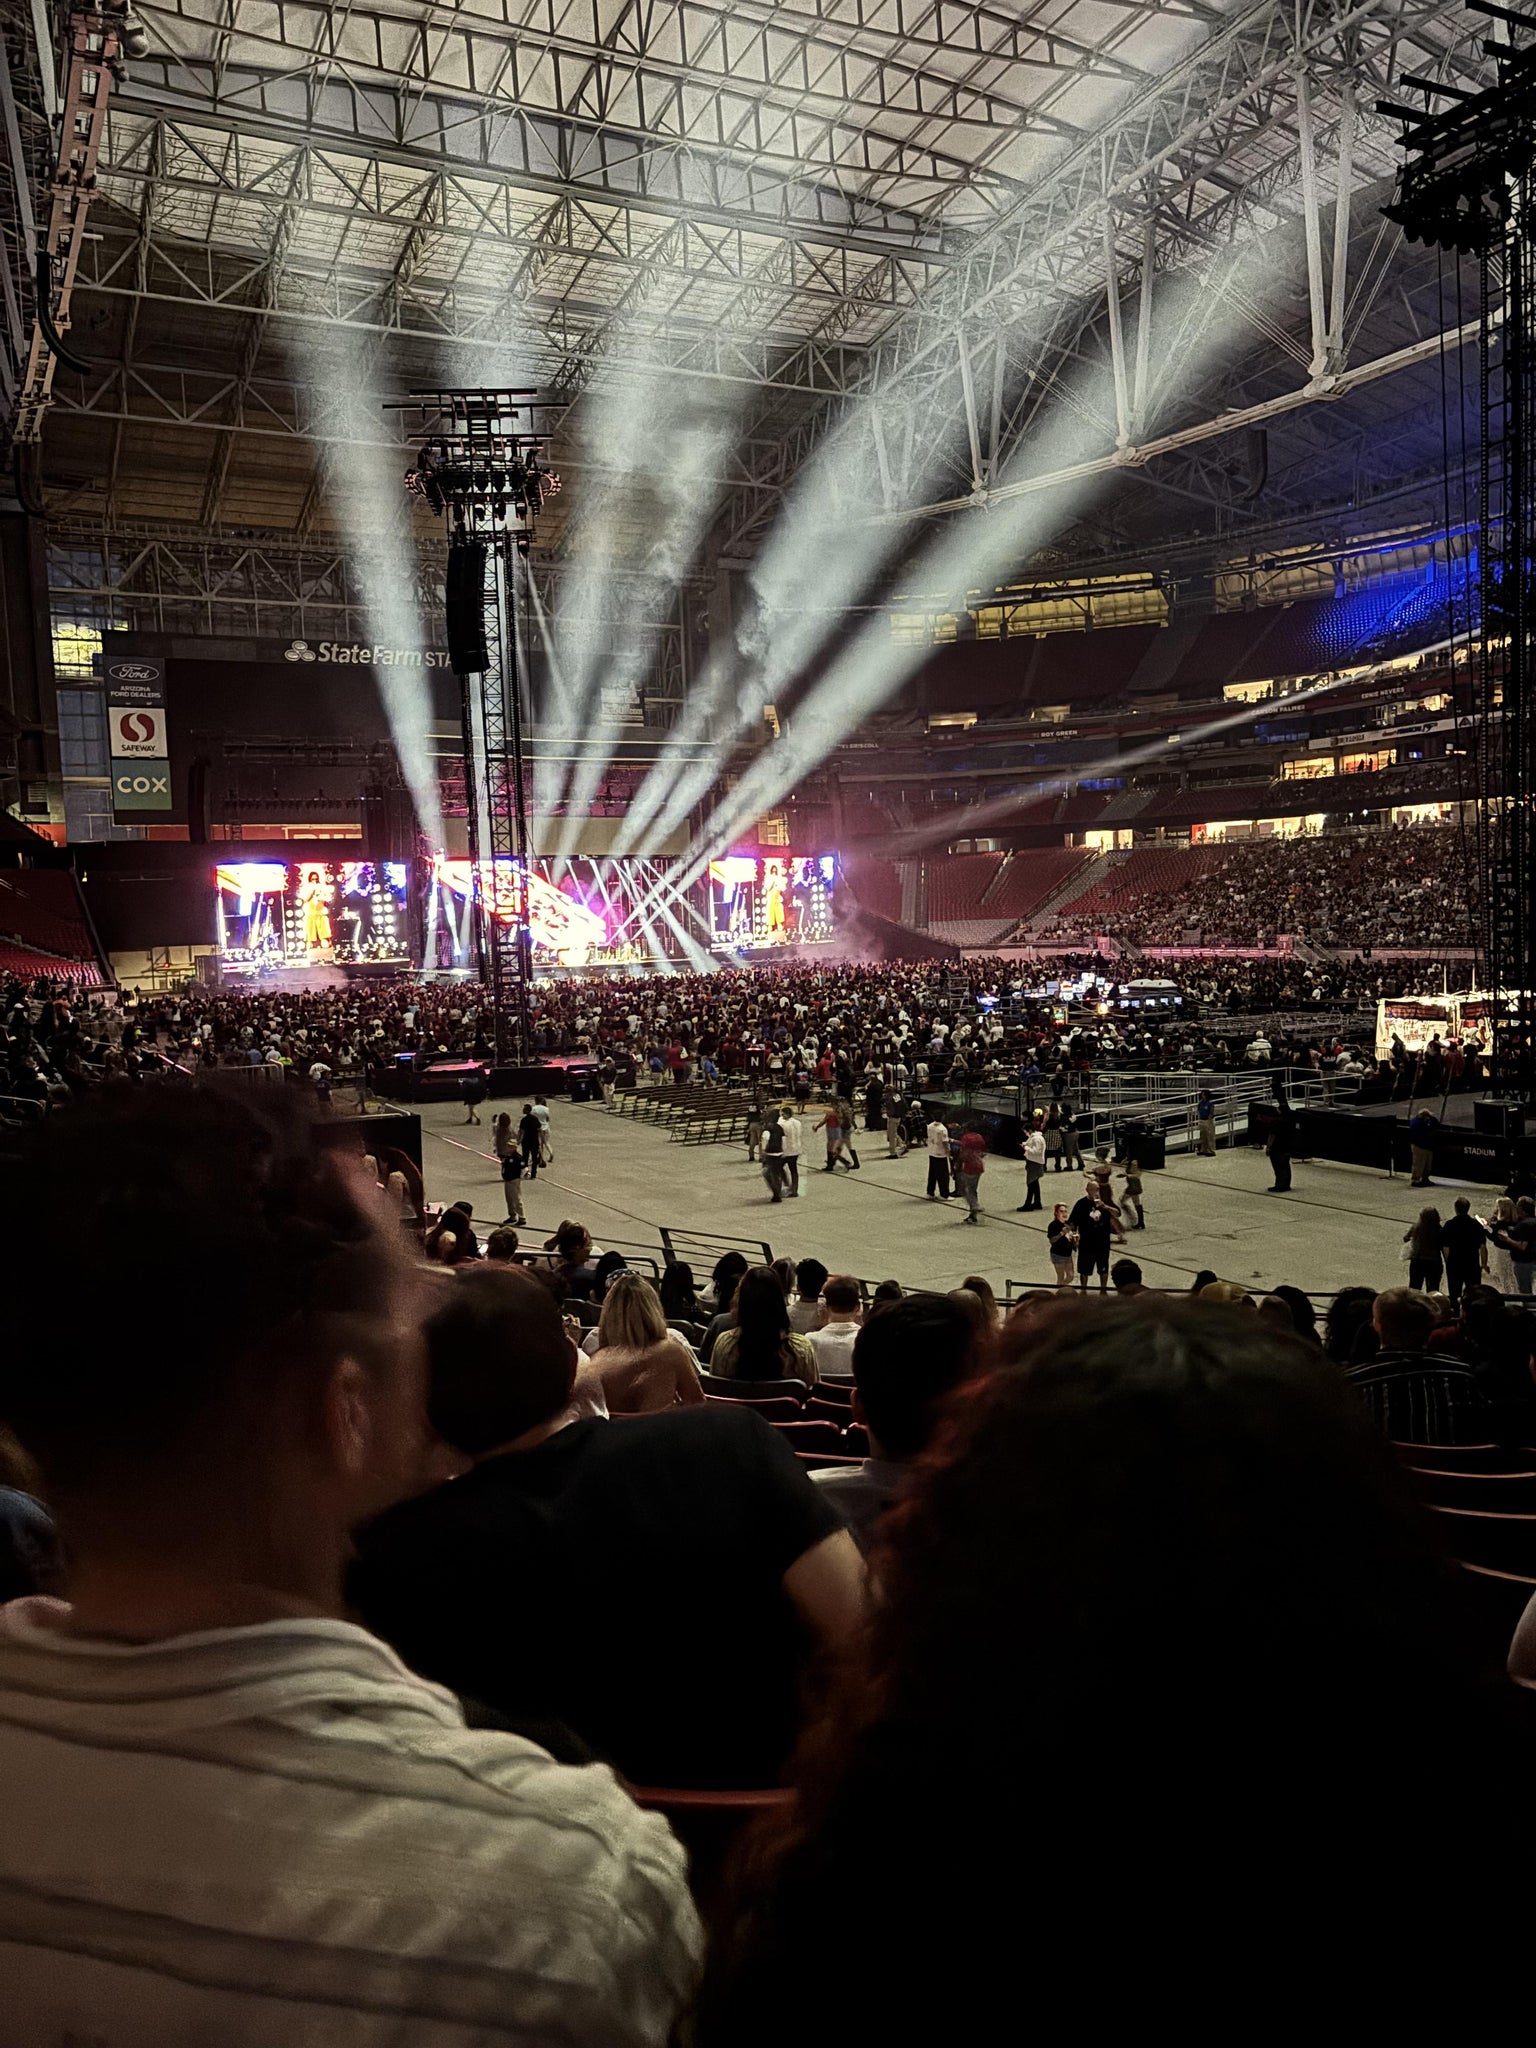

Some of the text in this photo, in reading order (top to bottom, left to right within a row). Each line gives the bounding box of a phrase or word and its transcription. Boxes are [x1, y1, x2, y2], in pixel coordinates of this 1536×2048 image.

[119, 665, 150, 679] Ford
[121, 744, 156, 752] SAFEWAY
[117, 776, 168, 793] COX
[311, 1030, 319, 1038] K
[750, 1056, 760, 1067] N
[1463, 1146, 1496, 1157] STADIUM
